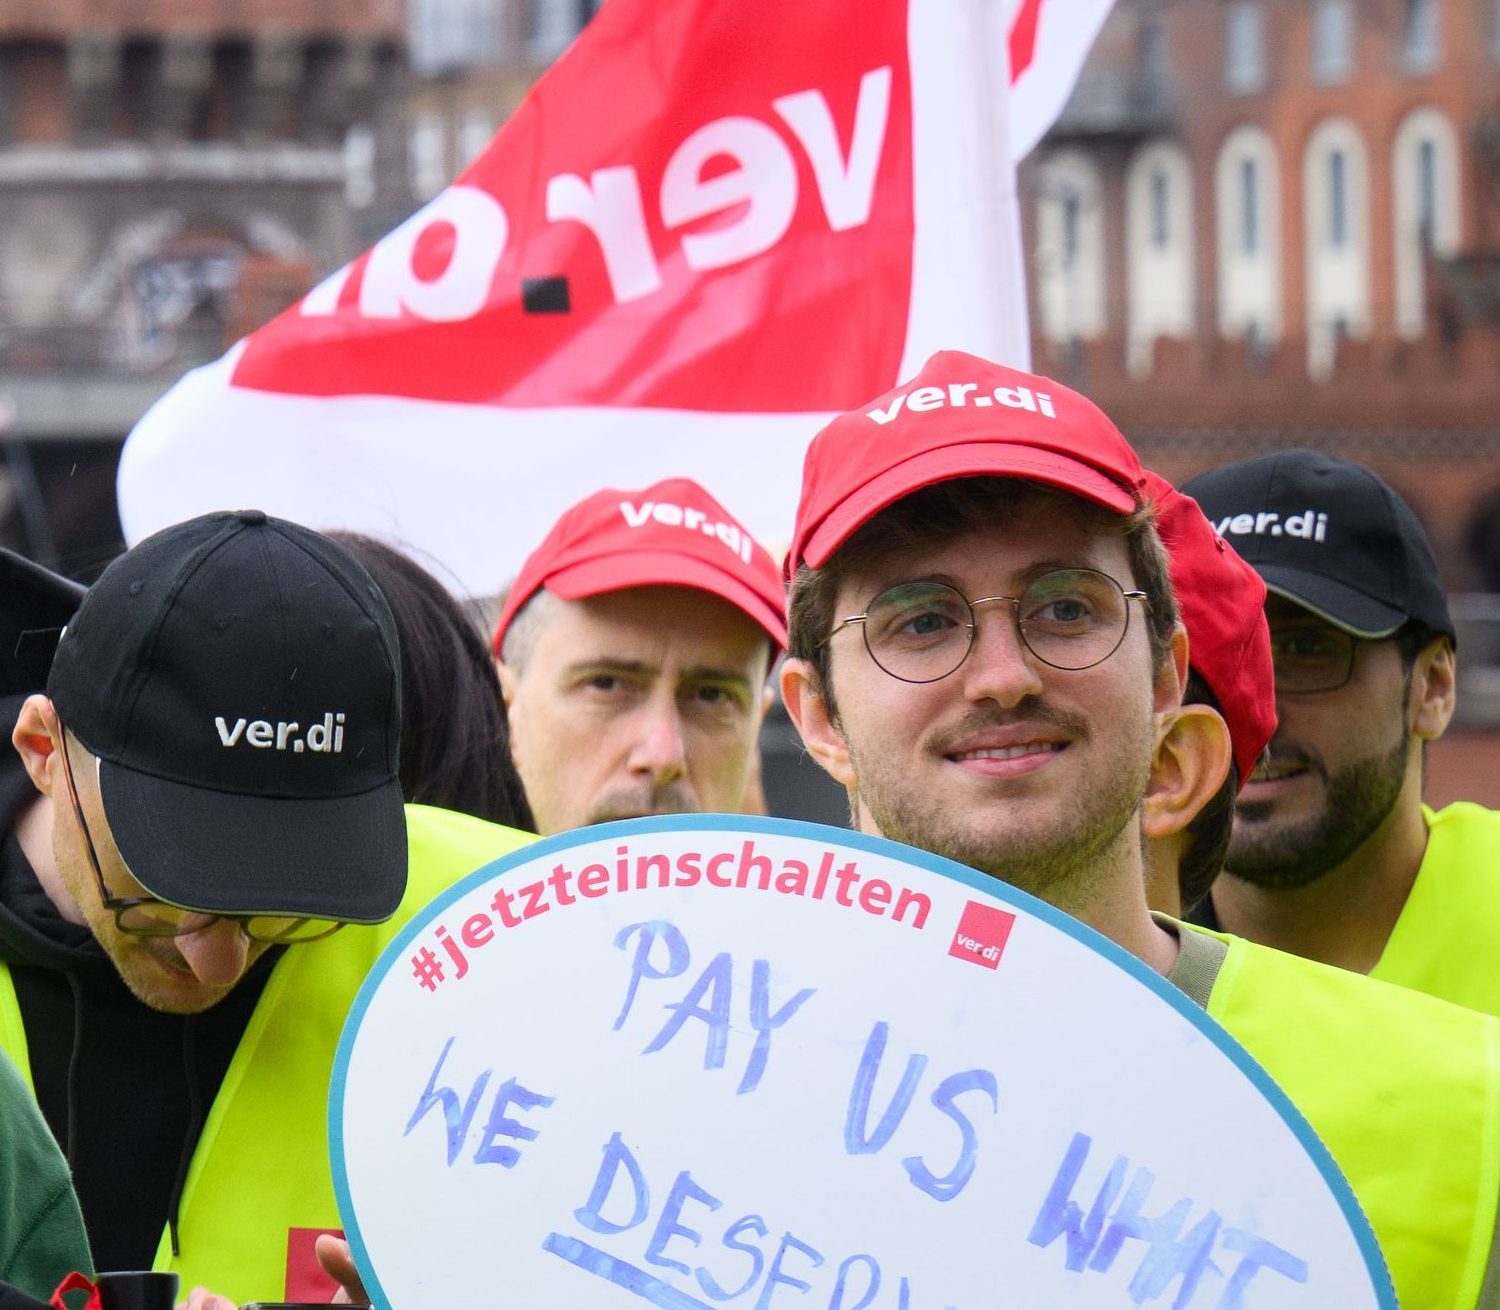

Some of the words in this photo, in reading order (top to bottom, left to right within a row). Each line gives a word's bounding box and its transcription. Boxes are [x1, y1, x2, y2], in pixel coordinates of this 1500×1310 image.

[866, 383, 1056, 426] ver.di
[618, 499, 752, 565] ver.di
[214, 712, 346, 754] ver.di
[411, 840, 932, 992] #jetzteinschalten
[957, 933, 1001, 961] ver.di
[613, 920, 818, 1095] PAY
[844, 1021, 999, 1202] US
[402, 1036, 556, 1169] WE
